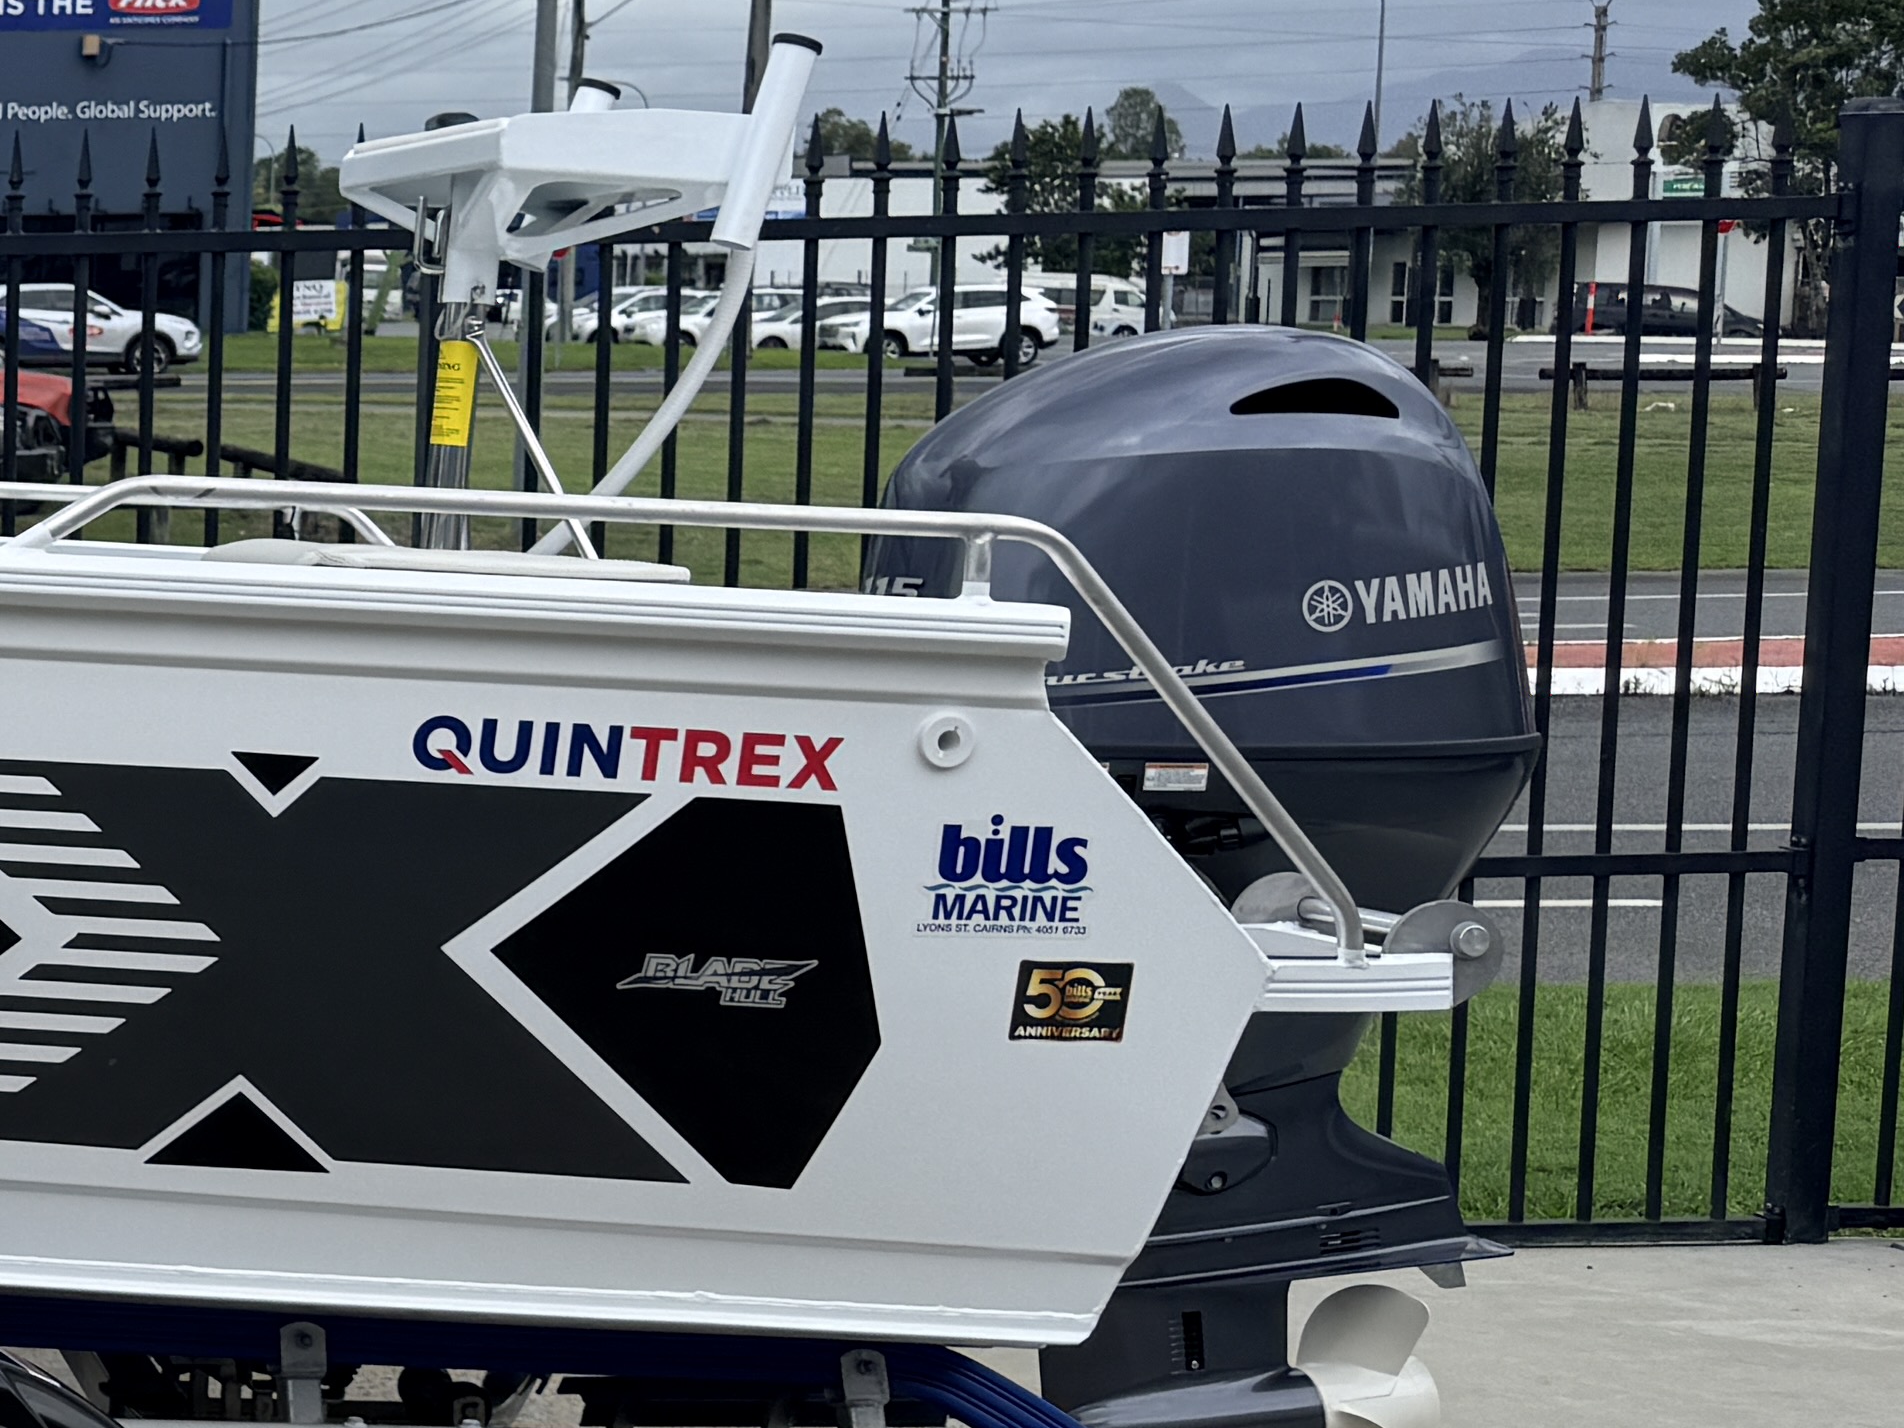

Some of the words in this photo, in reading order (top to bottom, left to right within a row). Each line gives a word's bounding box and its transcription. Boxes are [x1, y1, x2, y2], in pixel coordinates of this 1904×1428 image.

[7, 101, 73, 123] People.
[76, 100, 135, 119] Global
[138, 99, 216, 122] Support.
[1354, 561, 1493, 625] YAMAHA
[412, 714, 845, 792] QUINTREX
[938, 813, 1089, 886] bills
[932, 892, 1082, 923] MARINE
[916, 923, 952, 934] LYONS
[973, 923, 1014, 934] CAIRNS
[618, 953, 818, 990] BLADE
[1023, 967, 1106, 1019] 50
[1014, 1025, 1121, 1038] ANNIVERSARY
